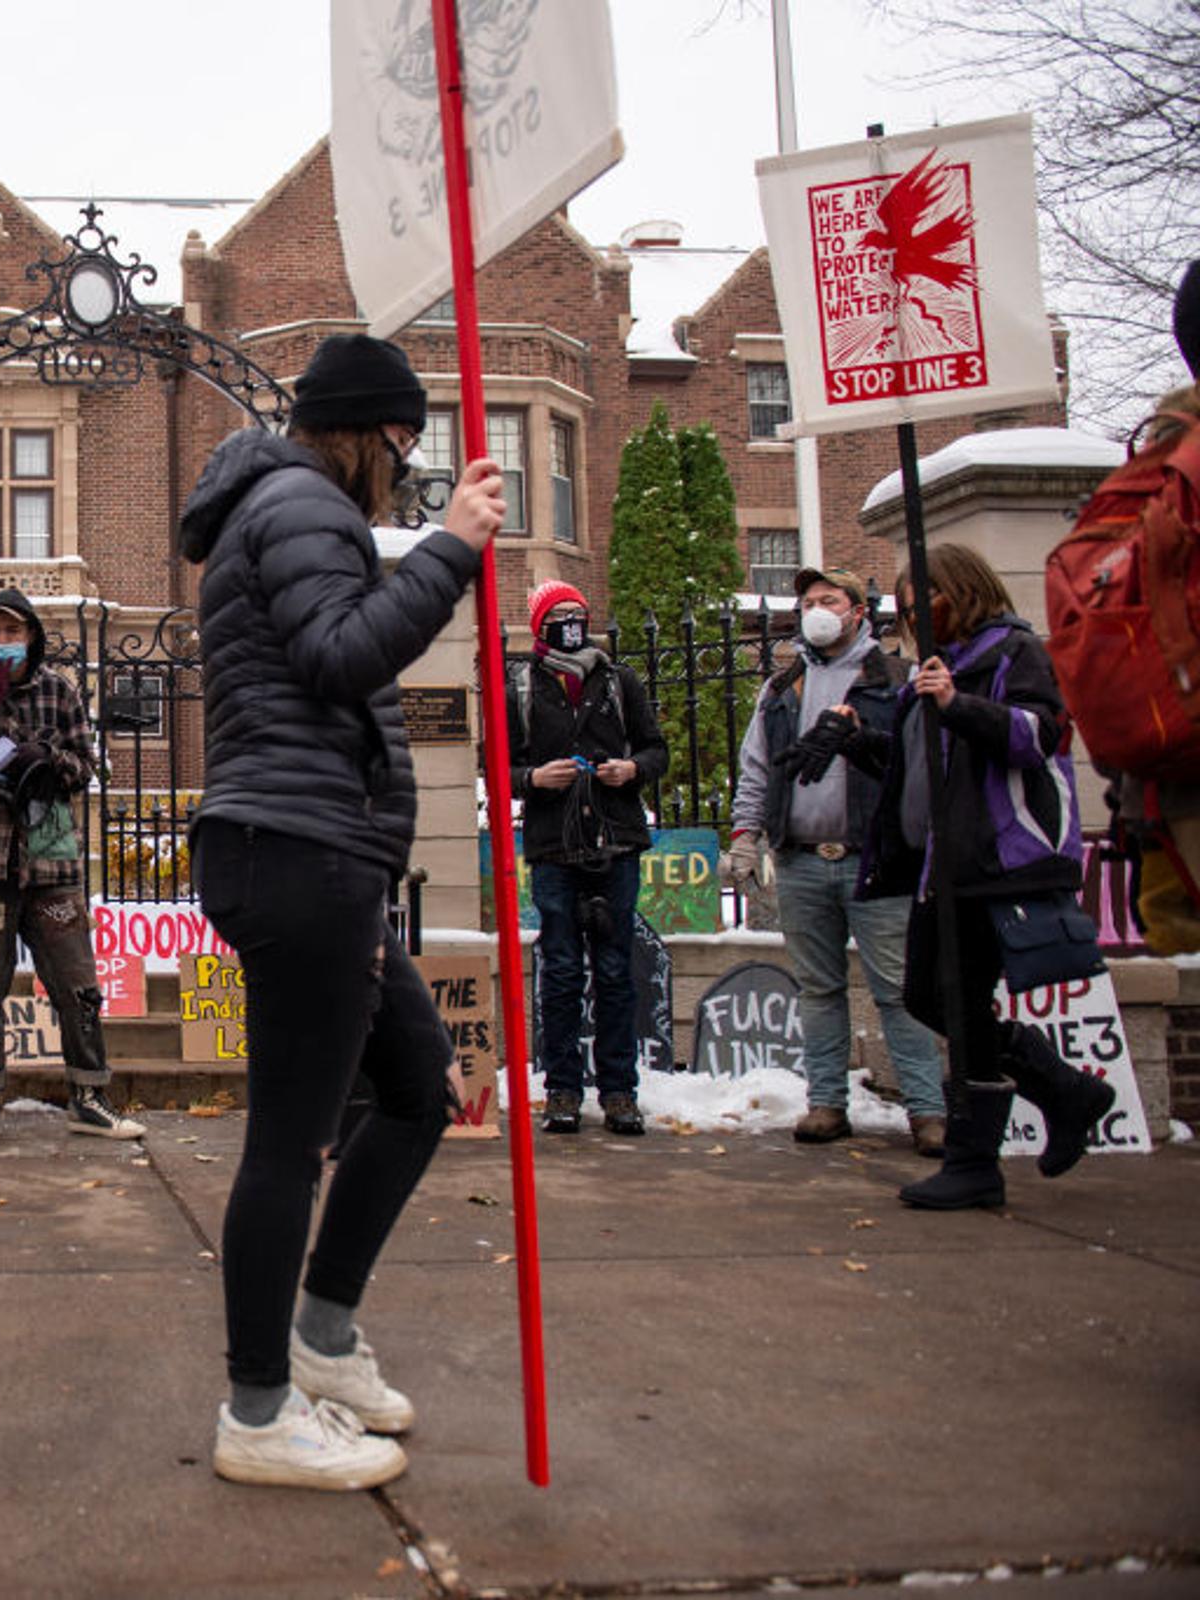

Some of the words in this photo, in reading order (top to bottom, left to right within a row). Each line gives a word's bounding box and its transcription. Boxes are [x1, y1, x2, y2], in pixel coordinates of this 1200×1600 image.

[816, 194, 844, 214] WE
[819, 211, 868, 234] HERE
[818, 236, 845, 255] TO
[822, 276, 861, 300] THE
[832, 367, 896, 399] STOP
[904, 358, 959, 392] LINE
[964, 355, 982, 383] 3
[431, 978, 477, 1009] THE
[703, 991, 805, 1039] FUCK
